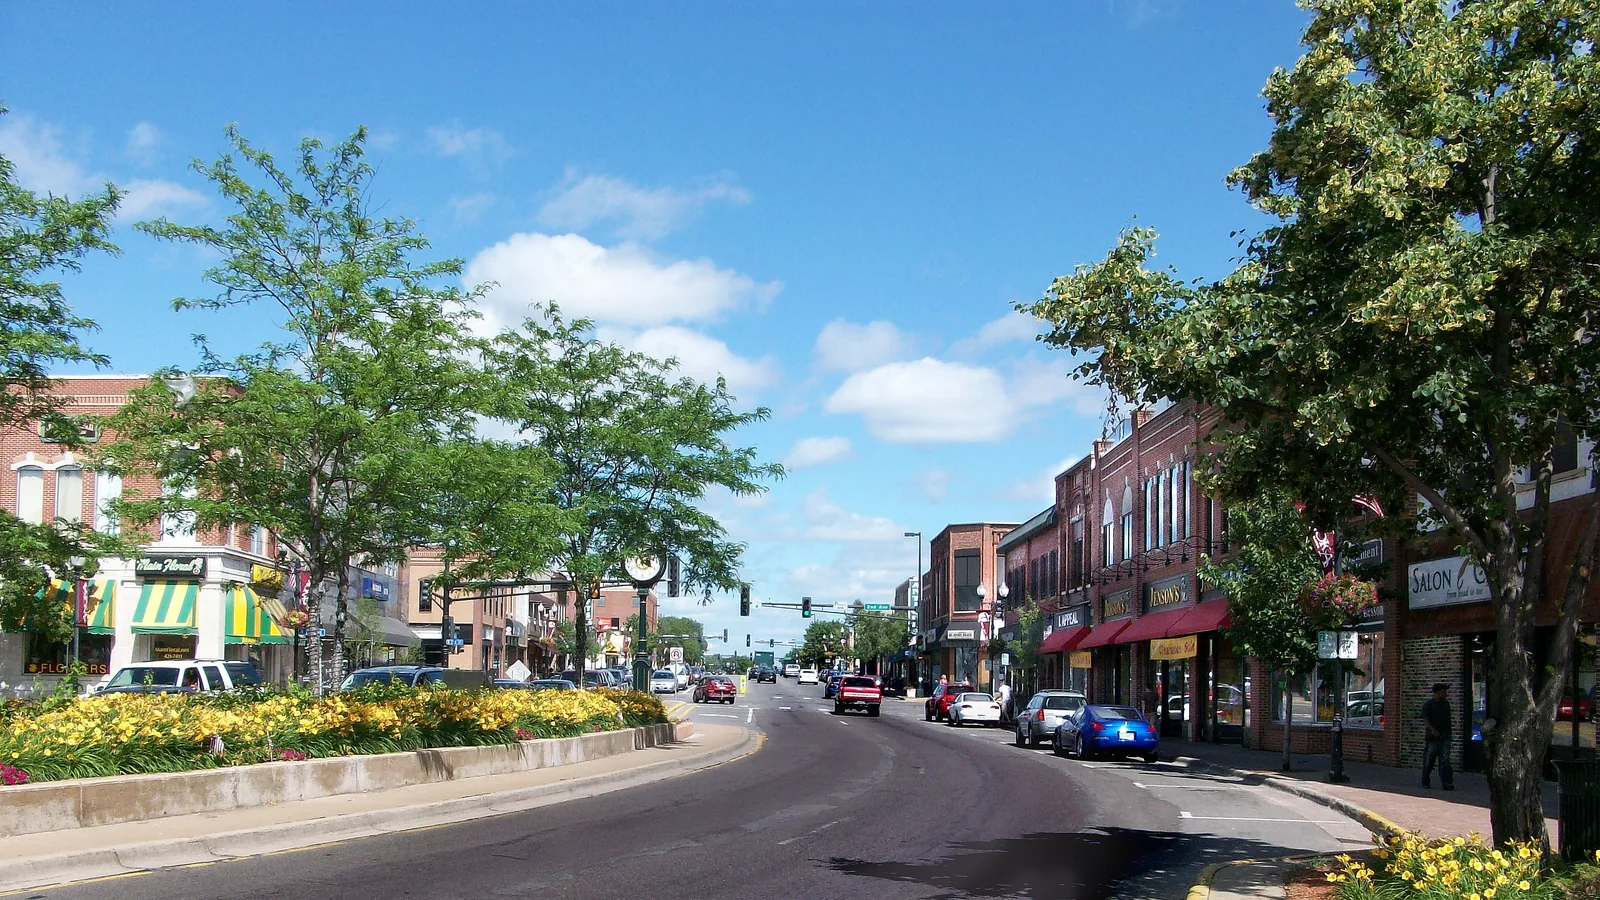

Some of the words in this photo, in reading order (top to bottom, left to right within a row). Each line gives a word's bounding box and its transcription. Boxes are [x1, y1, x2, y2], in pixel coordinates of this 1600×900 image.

[136, 558, 162, 571] Main
[162, 558, 195, 572] Floral
[1412, 567, 1452, 594] SALON
[1150, 584, 1180, 608] JENSON'S
